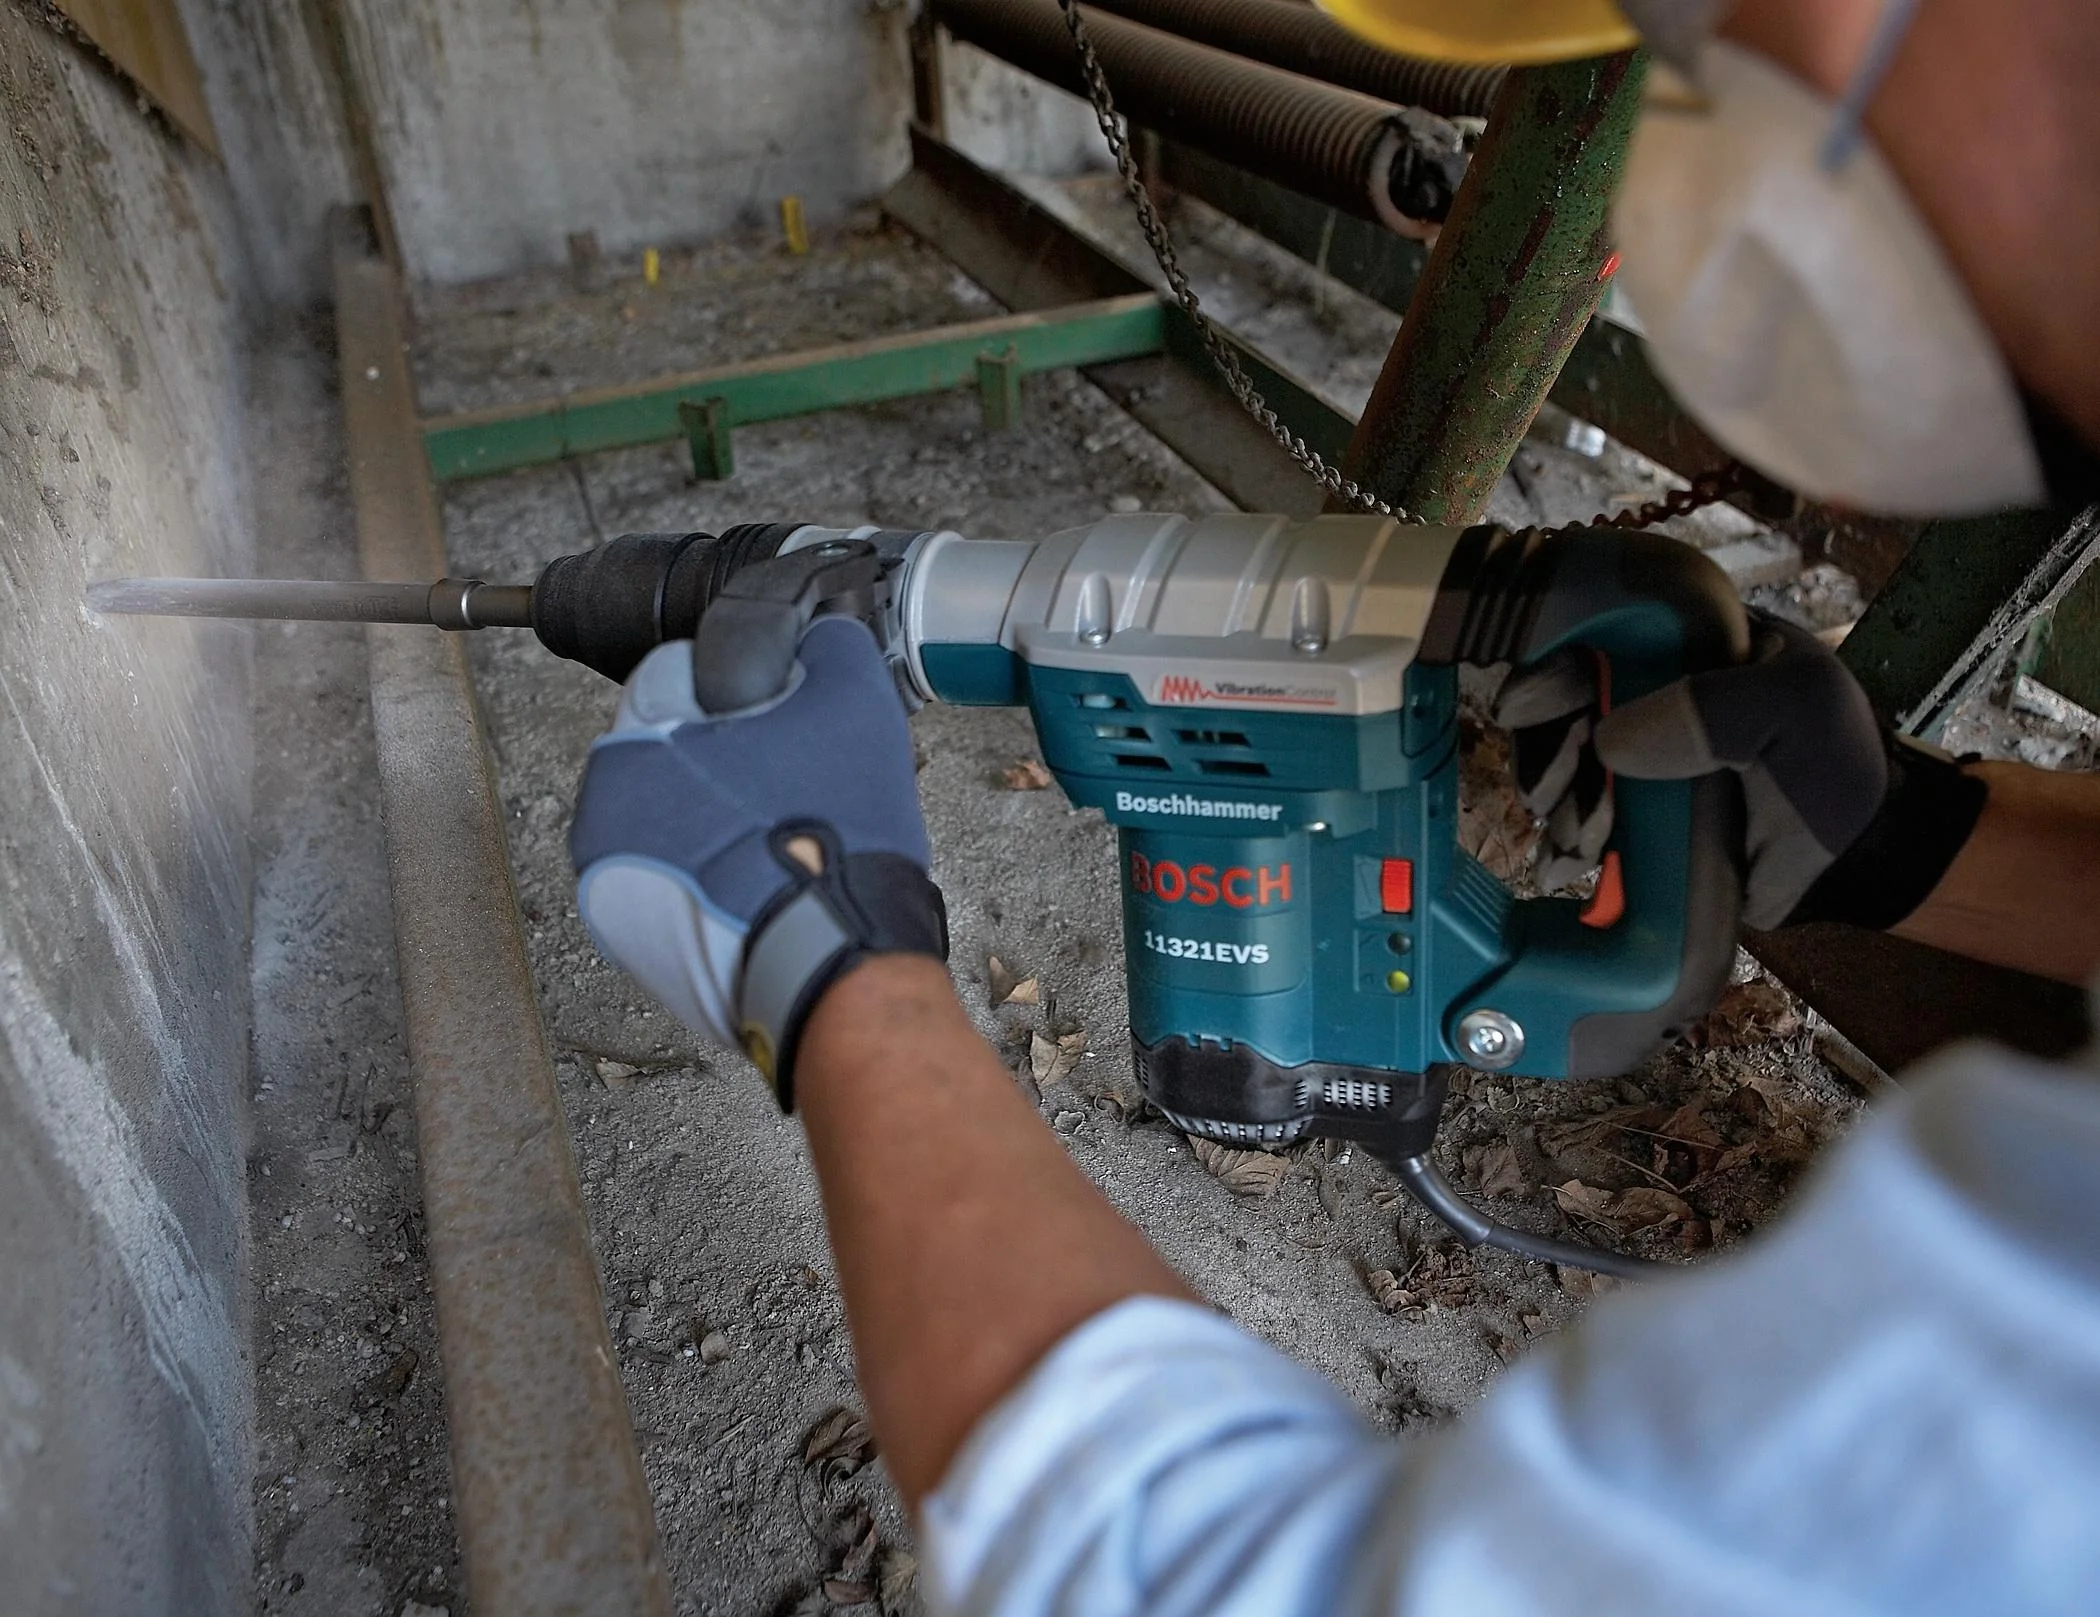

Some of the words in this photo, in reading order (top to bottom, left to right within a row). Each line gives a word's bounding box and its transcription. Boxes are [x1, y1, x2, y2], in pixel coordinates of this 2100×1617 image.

[1116, 792, 1282, 821] Boschhammer
[1131, 851, 1292, 908] BOSCH
[1145, 930, 1270, 964] 11321EVS
